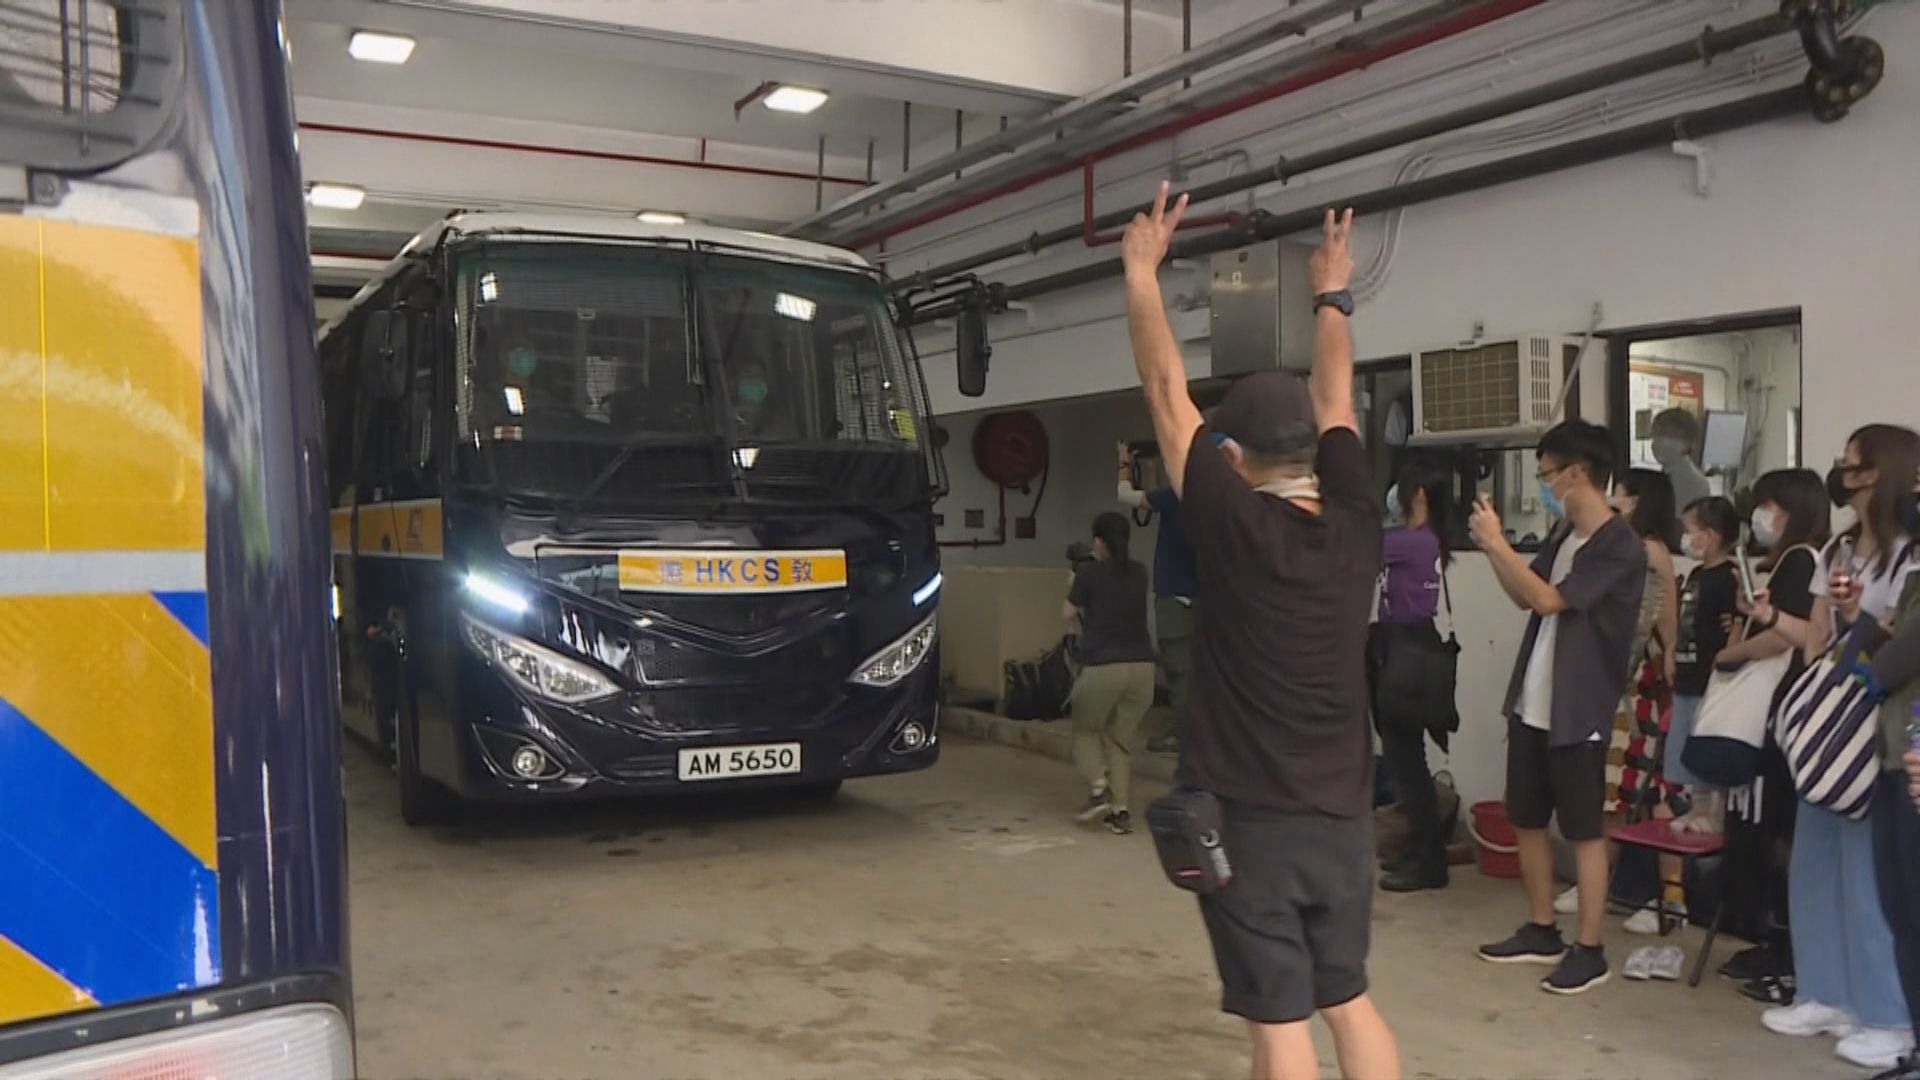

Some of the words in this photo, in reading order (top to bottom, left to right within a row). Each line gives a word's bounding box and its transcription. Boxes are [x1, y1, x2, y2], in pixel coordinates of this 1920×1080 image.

[696, 558, 780, 583] HKCS
[688, 753, 721, 776] AM
[729, 748, 794, 772] 5650
